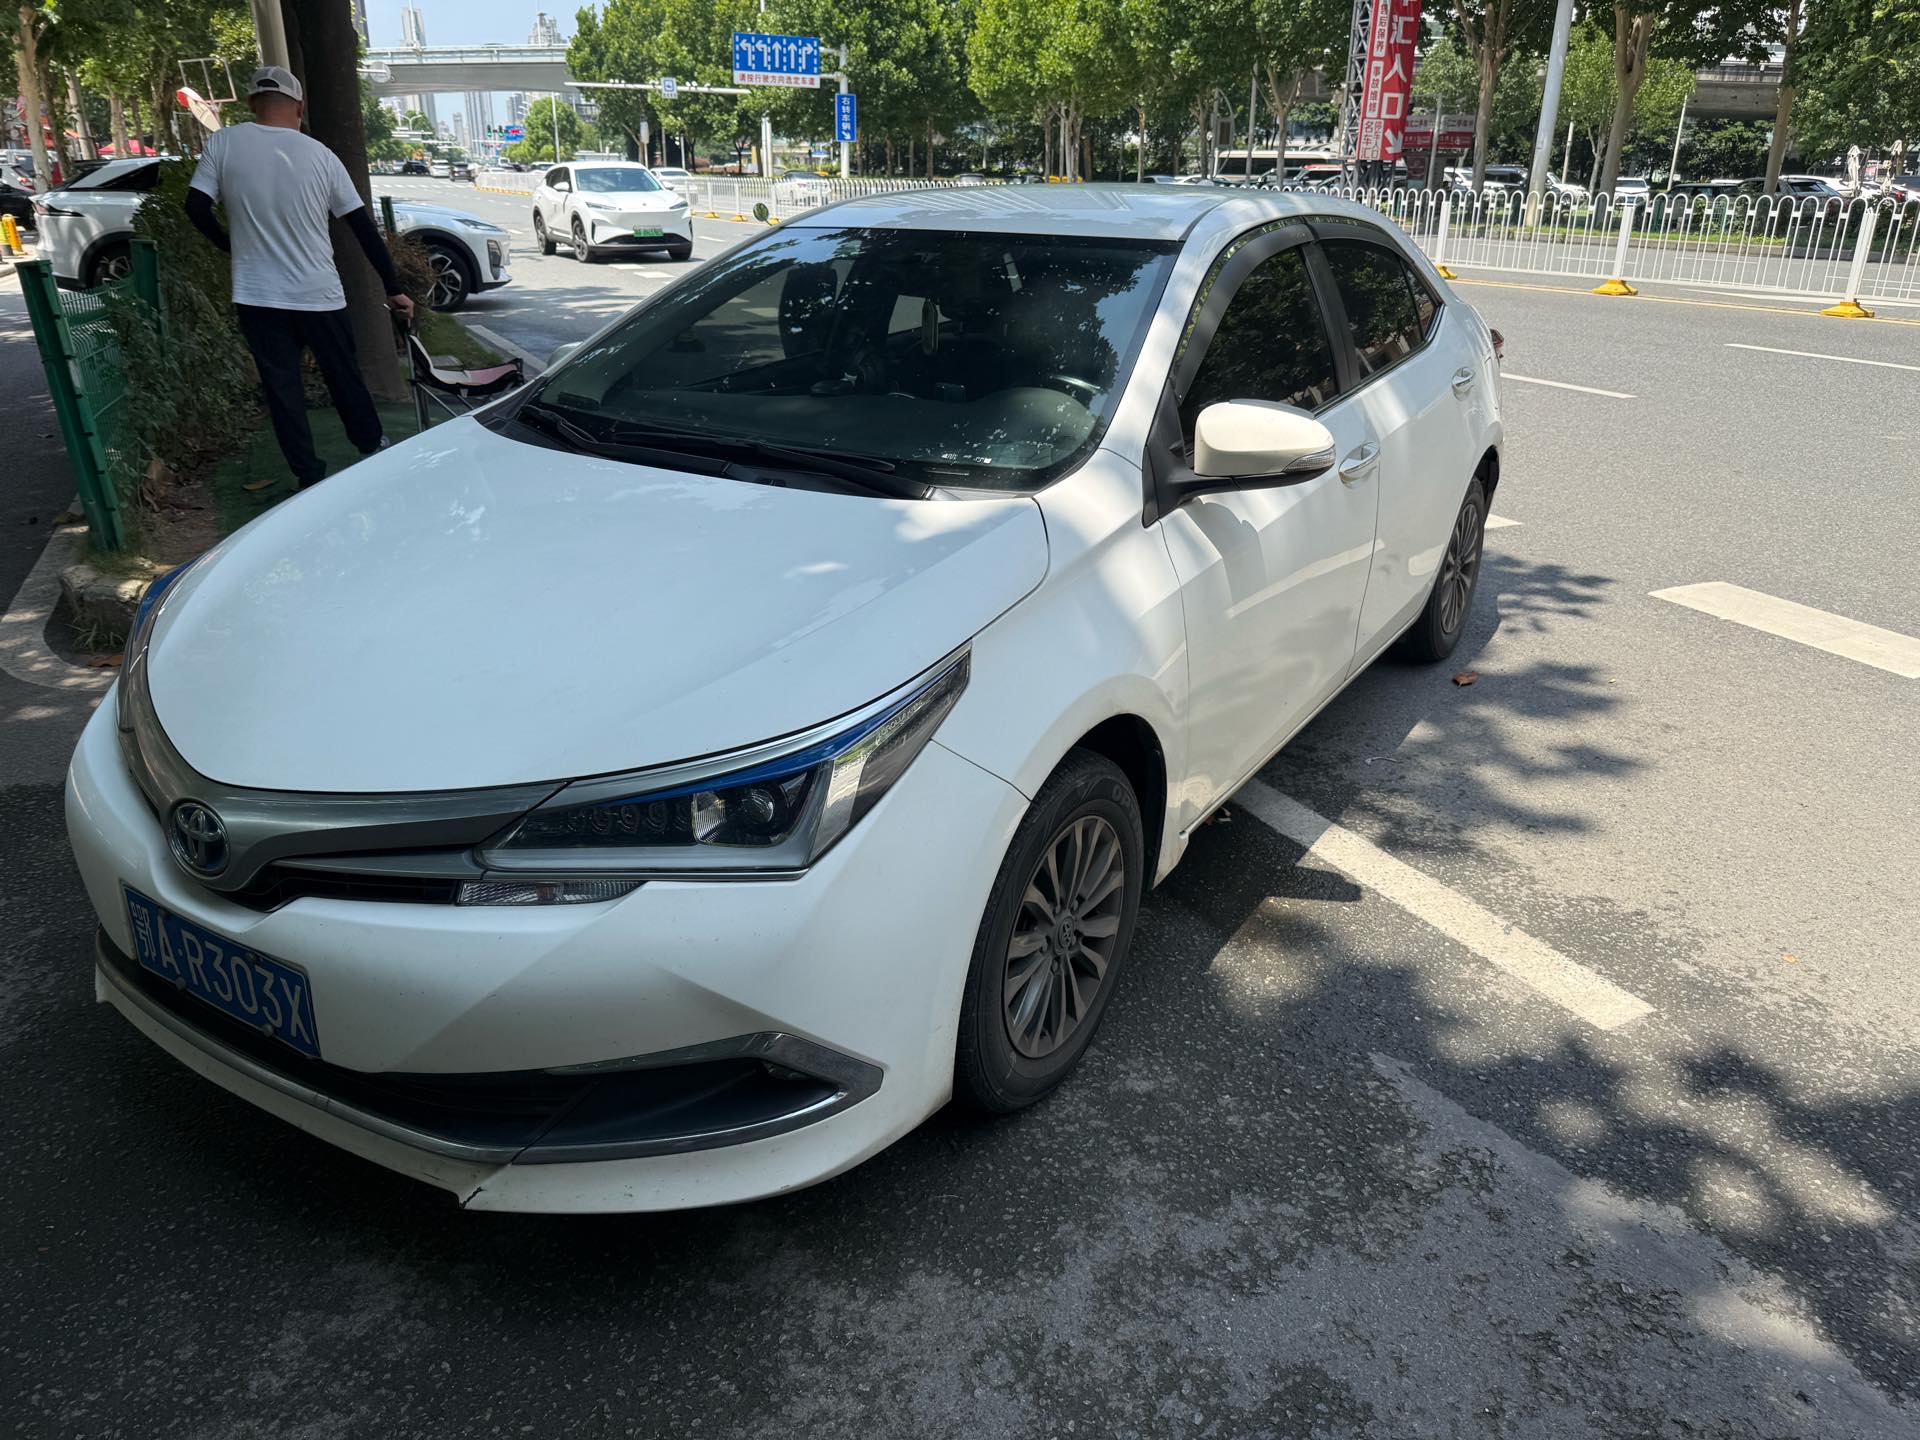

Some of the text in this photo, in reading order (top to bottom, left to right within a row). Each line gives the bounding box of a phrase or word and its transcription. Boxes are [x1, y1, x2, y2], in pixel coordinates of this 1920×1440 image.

[739, 73, 815, 86] 请按行驶方向选定车道
[1381, 0, 1415, 119] 汇入口
[1369, 66, 1381, 112] 事故维修
[1361, 121, 1374, 159] 名车汇
